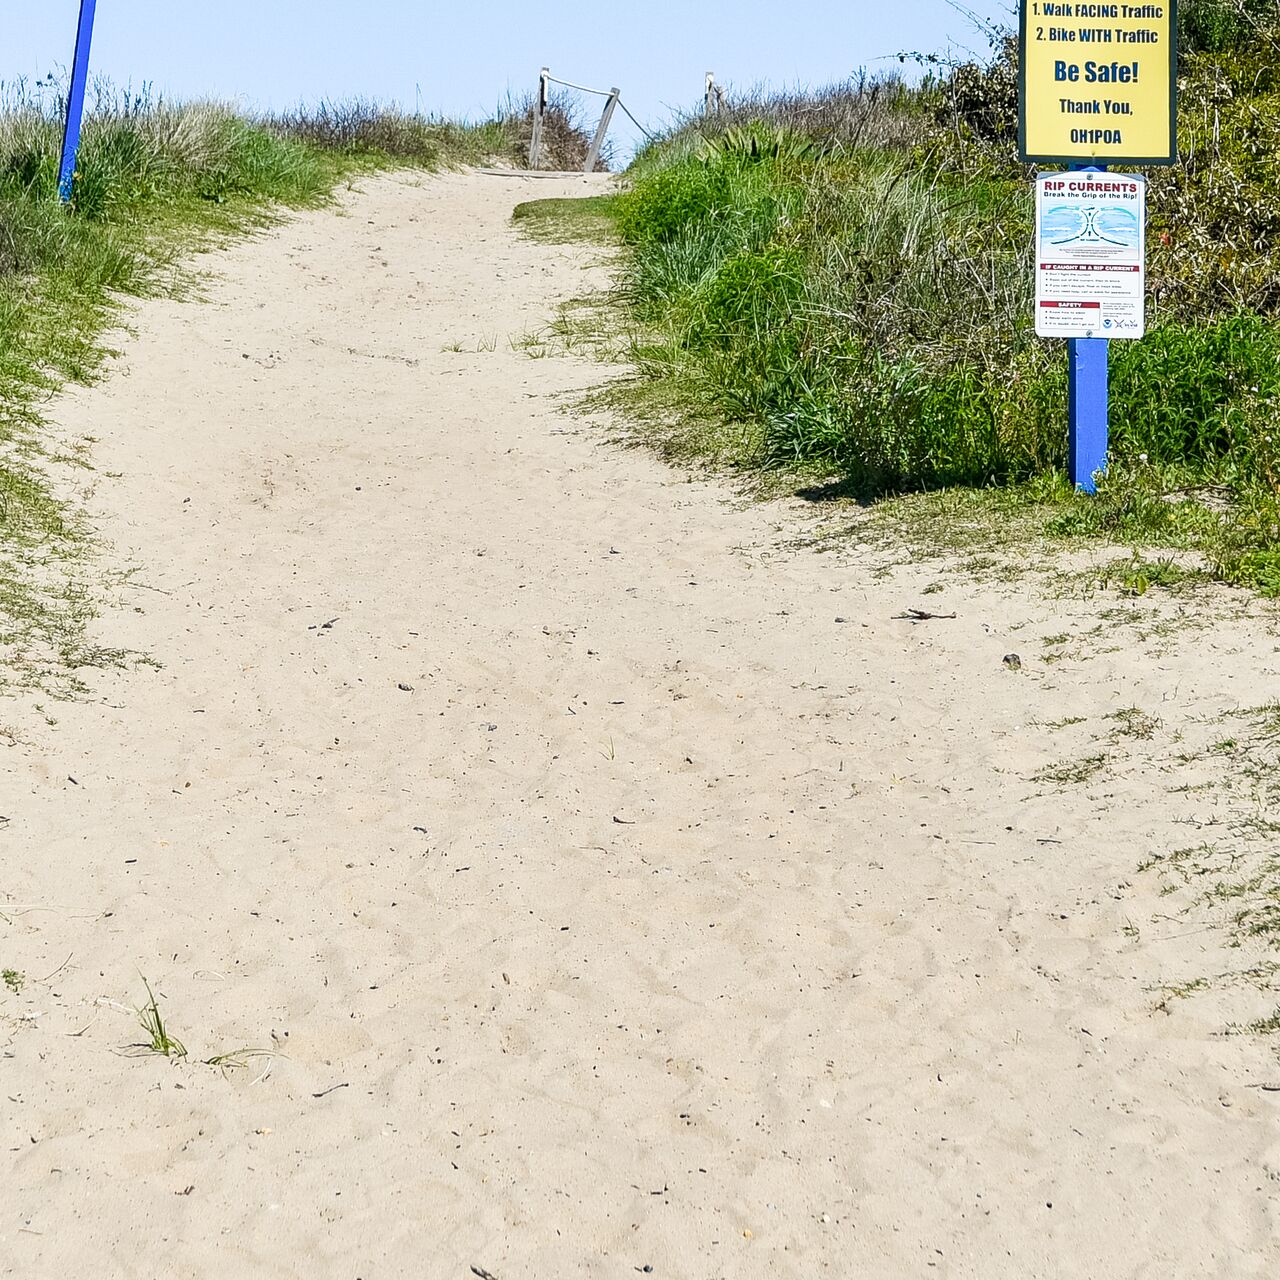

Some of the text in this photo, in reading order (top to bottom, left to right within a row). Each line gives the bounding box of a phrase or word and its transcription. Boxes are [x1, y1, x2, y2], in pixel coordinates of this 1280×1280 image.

[1032, 3, 1163, 18] 1. Walk FACING Traffic
[1036, 27, 1158, 43] 2. Bike WITH Traffic
[1055, 61, 1138, 83] Be Safe!
[1059, 99, 1133, 116] Thank You,
[1044, 182, 1137, 192] RIP CURRENTS
